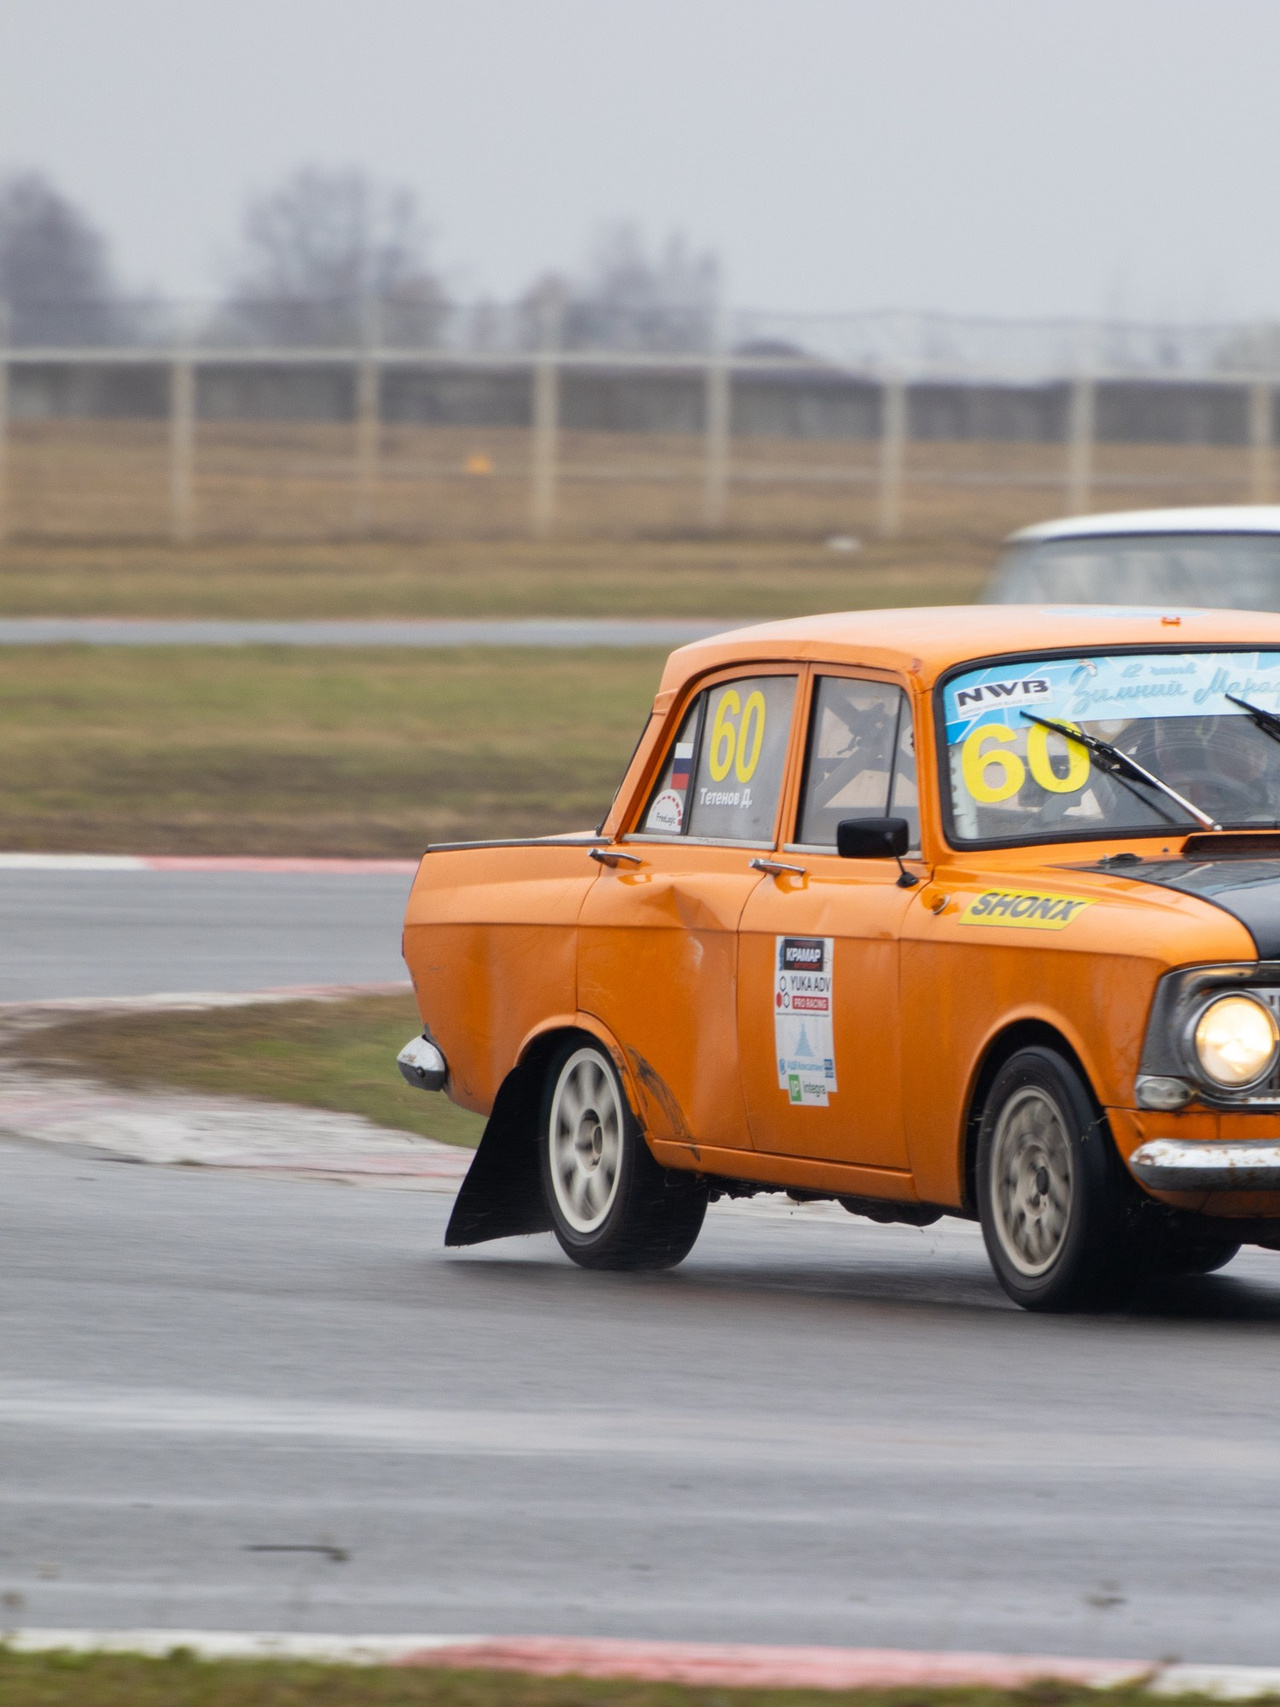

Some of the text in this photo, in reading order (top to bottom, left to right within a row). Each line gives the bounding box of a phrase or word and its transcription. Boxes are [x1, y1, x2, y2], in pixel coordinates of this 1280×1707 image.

[956, 679, 1049, 707] NWB
[709, 689, 766, 783] 60
[961, 718, 1091, 803] 60
[700, 787, 753, 809] Тетенов Д.
[971, 892, 1086, 921] SHONX
[786, 947, 822, 963] КРАМАР
[790, 975, 831, 993] YUKA ADV
